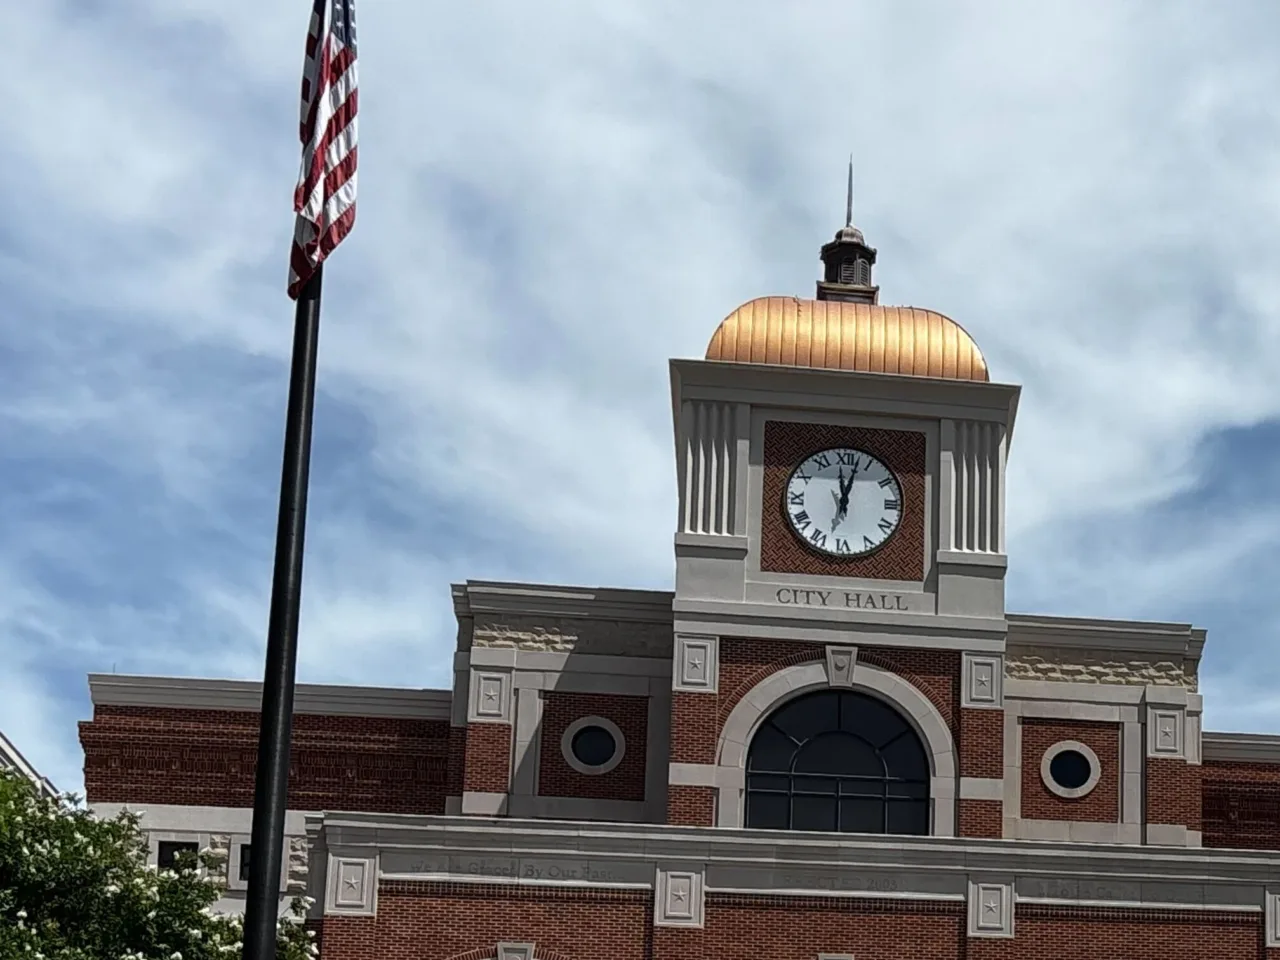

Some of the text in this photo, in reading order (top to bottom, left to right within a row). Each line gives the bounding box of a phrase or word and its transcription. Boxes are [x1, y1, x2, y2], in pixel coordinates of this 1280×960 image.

[836, 452, 854, 466] XII
[776, 588, 909, 610] CITY HALL
